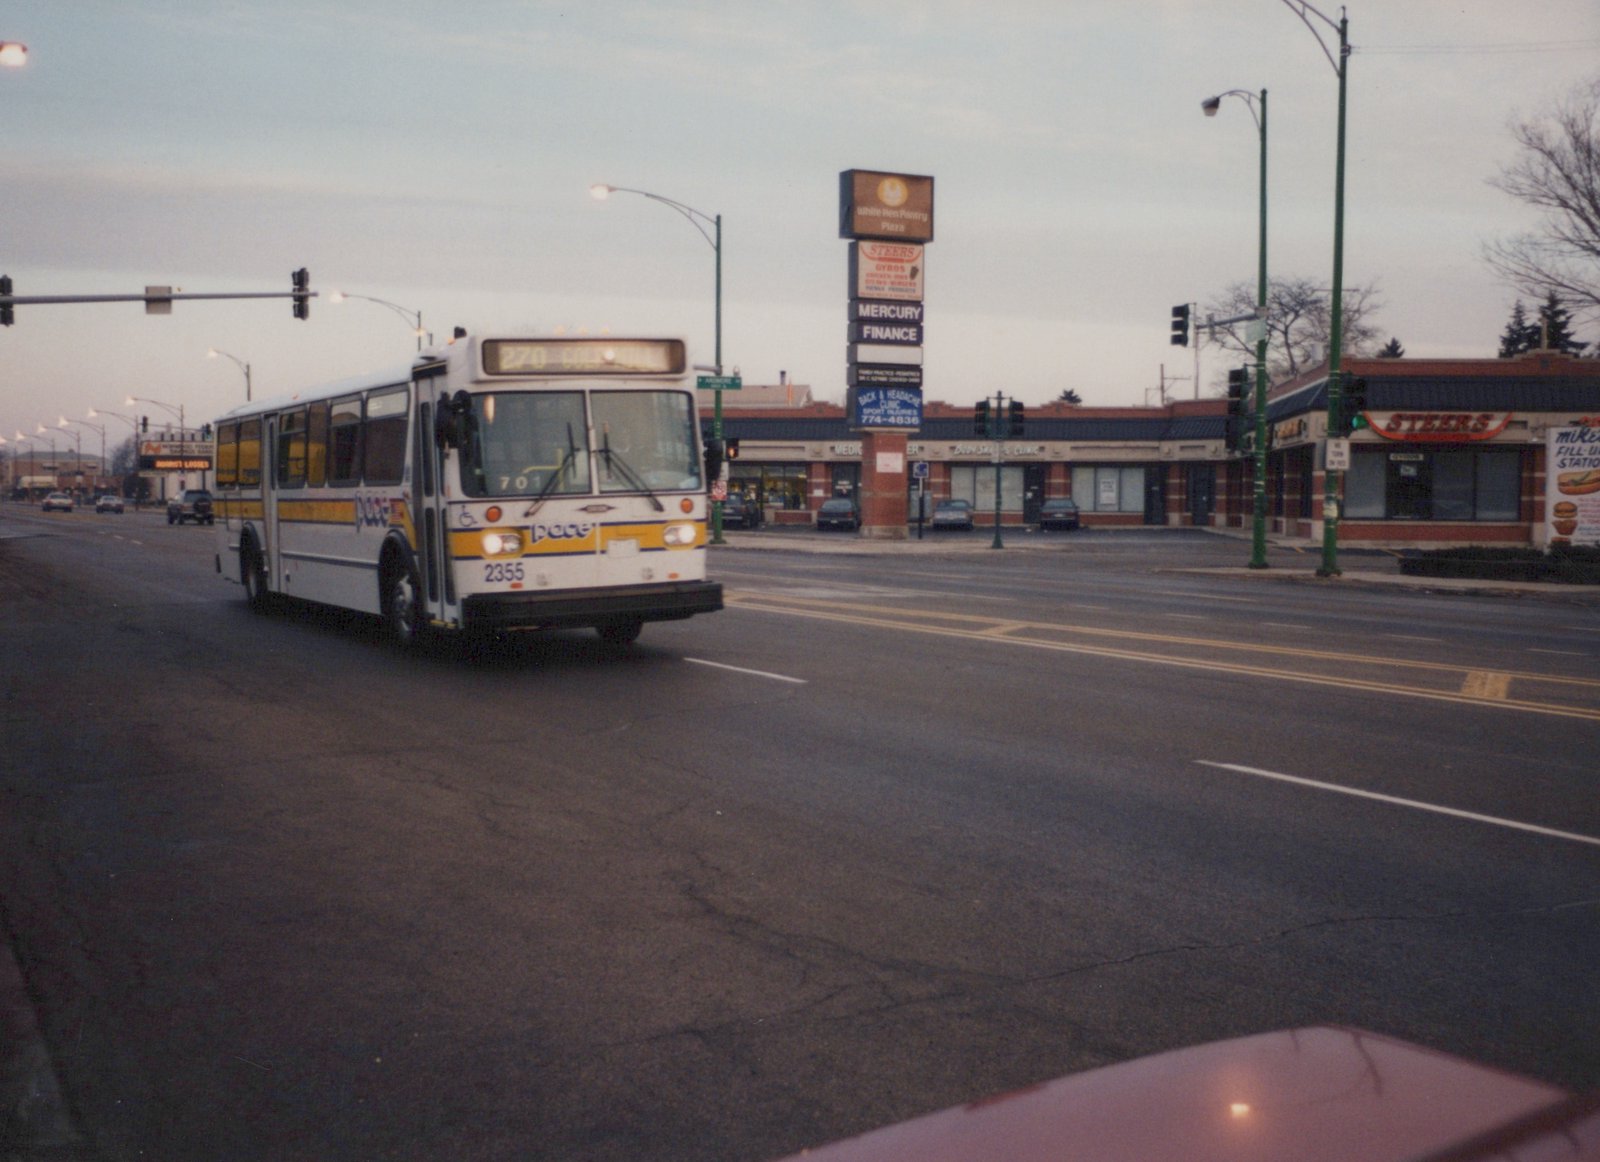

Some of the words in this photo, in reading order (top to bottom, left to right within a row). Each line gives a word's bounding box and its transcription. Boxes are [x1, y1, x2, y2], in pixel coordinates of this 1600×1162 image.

[881, 221, 905, 233] Plaza
[870, 243, 915, 258] STEERS
[875, 263, 906, 272] GYROS
[858, 303, 922, 320] MERCURY
[862, 325, 918, 341] FINANCE
[857, 390, 877, 406] BACK
[887, 389, 921, 408] HEADACHE
[879, 399, 901, 410] CLINIC
[862, 407, 885, 415] SPORT
[1386, 412, 1496, 433] STEERS
[529, 522, 594, 545] pace
[484, 561, 525, 583] 2355
